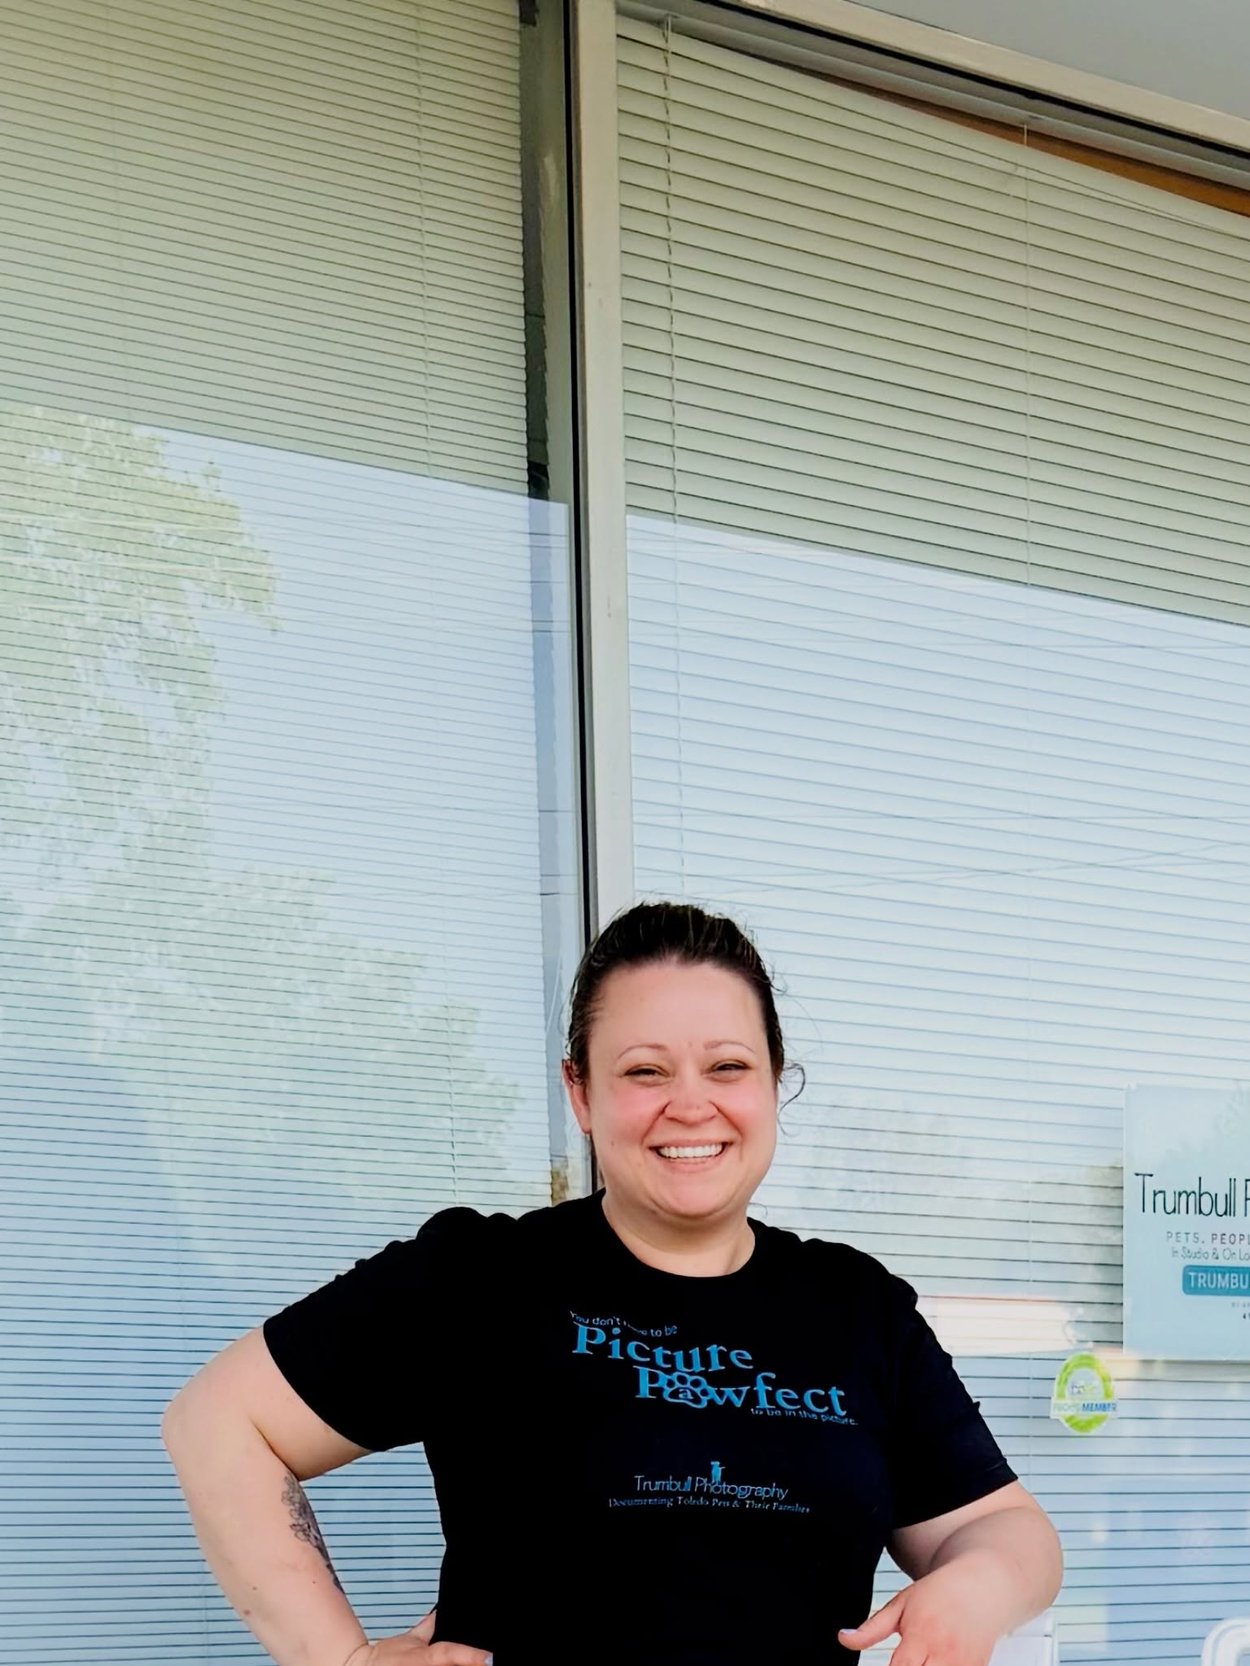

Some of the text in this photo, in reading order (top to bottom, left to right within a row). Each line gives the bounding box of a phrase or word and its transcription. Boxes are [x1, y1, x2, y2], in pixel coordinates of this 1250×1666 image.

[1134, 1173, 1236, 1217] Trumbull
[1166, 1231, 1205, 1244] PETS.
[1181, 1248, 1209, 1260] Studio
[592, 1316, 620, 1326] don't
[650, 1329, 662, 1337] to
[572, 1321, 754, 1373] Picture
[633, 1365, 847, 1416] Pawfect
[634, 1475, 789, 1500] Trumbull Photography
